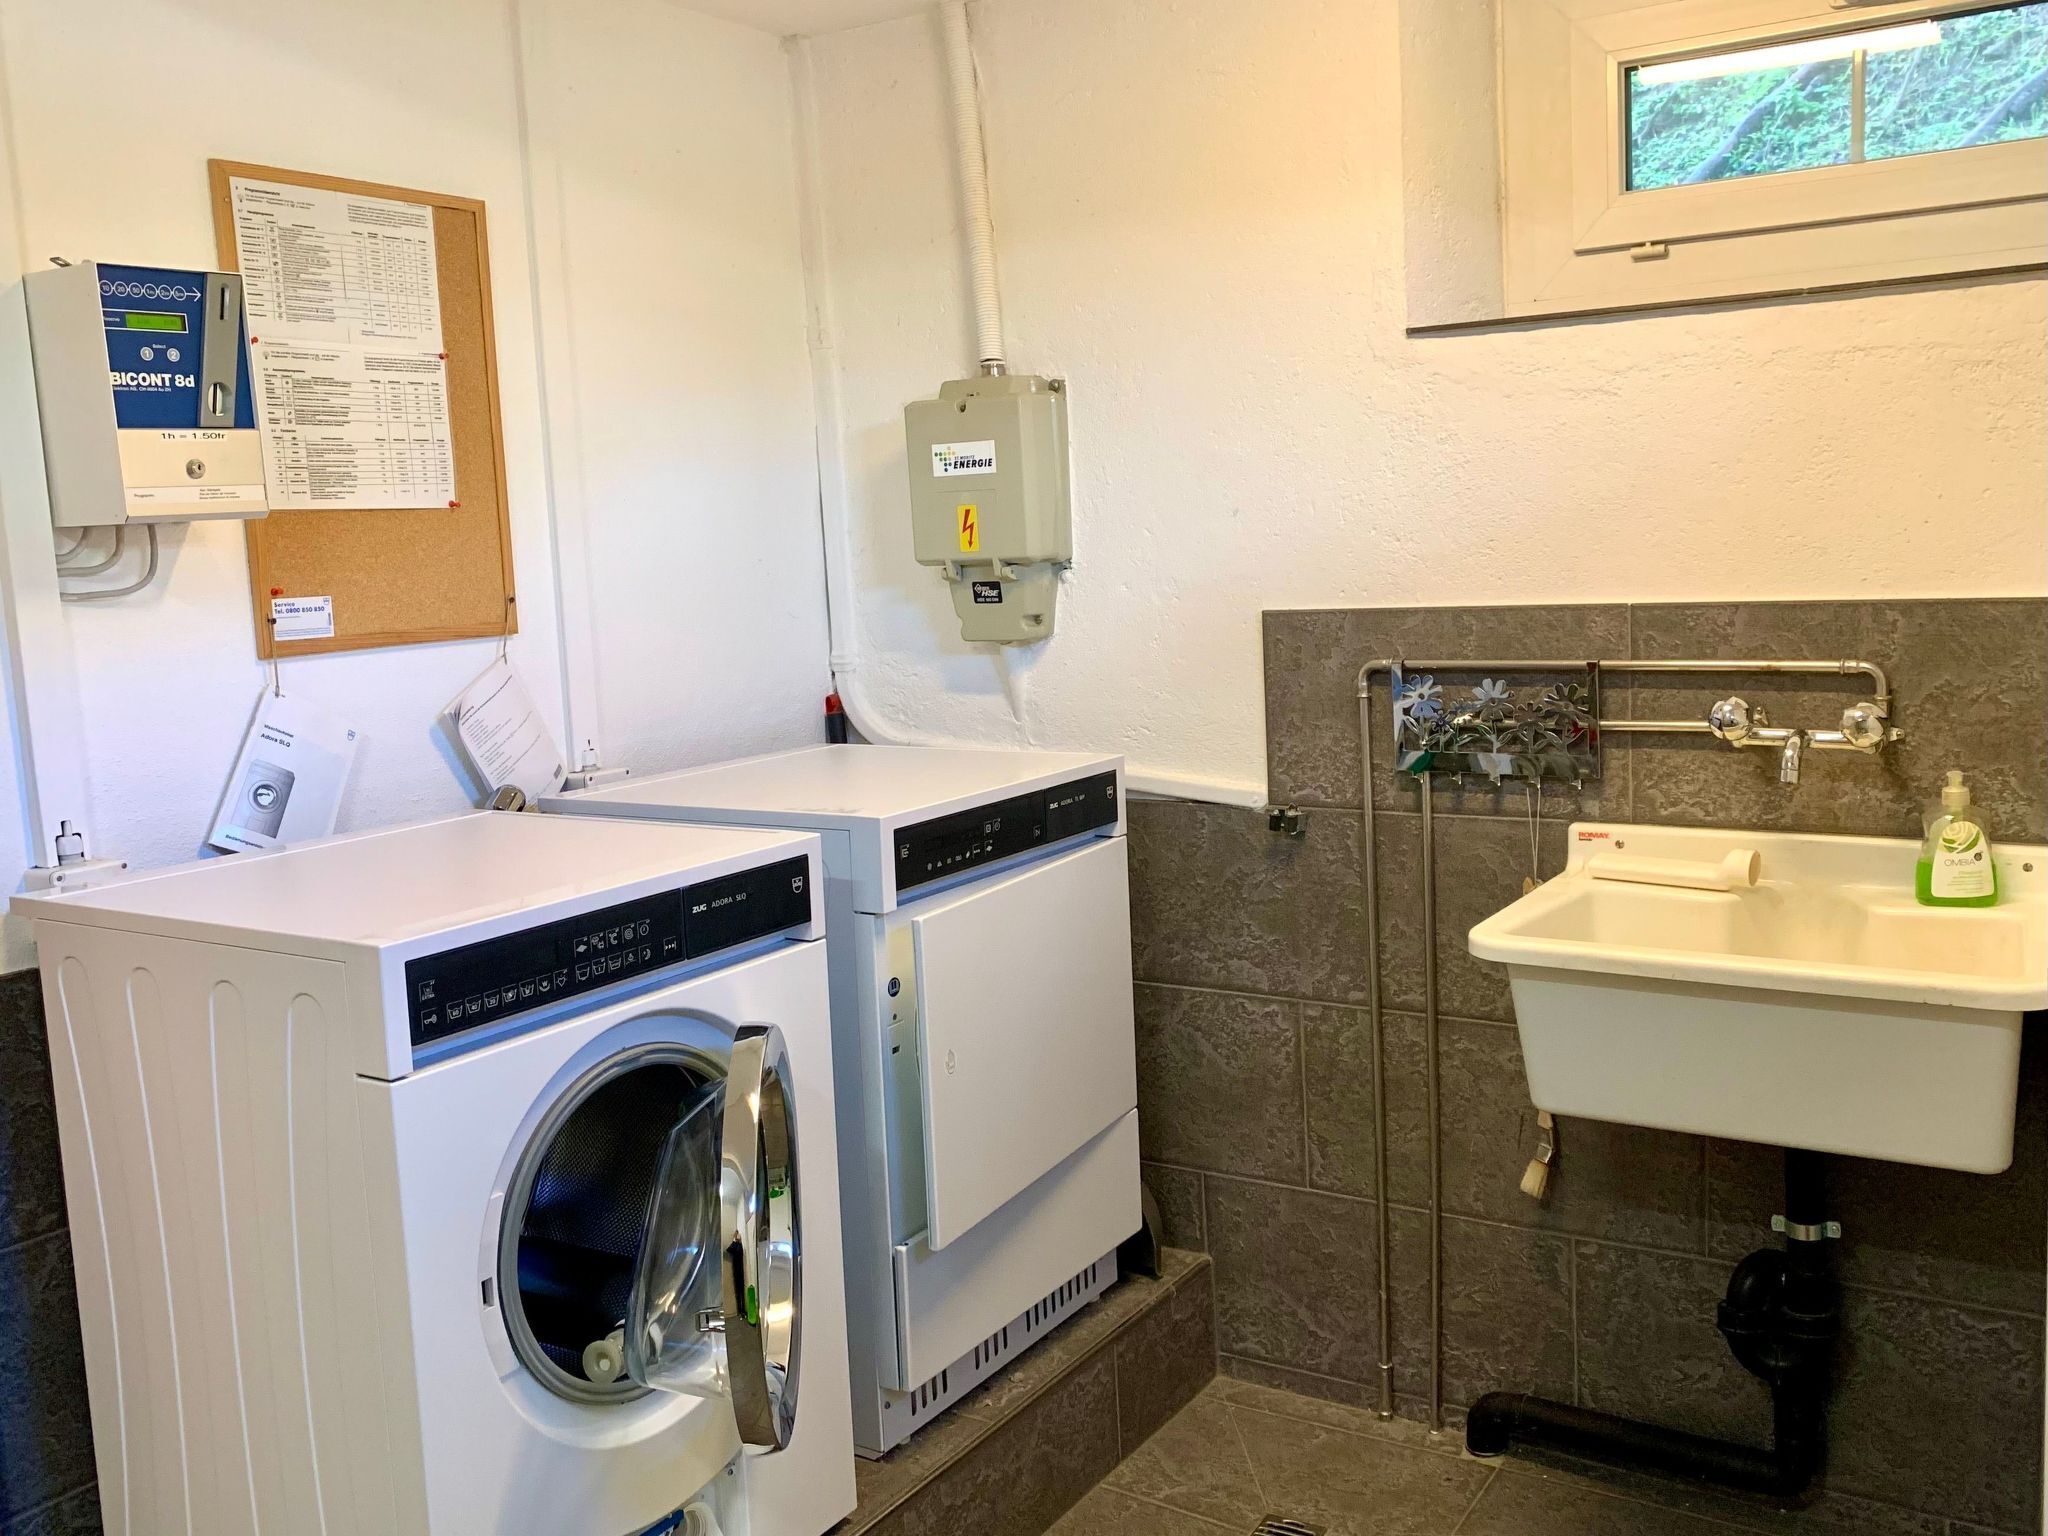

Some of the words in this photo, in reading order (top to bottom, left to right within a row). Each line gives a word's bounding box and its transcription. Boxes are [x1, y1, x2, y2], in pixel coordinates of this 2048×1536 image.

[110, 371, 171, 386] BICONT
[175, 374, 195, 387] 8d
[161, 432, 175, 440] 1h
[953, 458, 993, 469] ENERGIE
[261, 733, 278, 742] Adora
[1944, 858, 1976, 867] OMBIA
[692, 903, 707, 913] ZUG
[711, 896, 733, 908] ADORA
